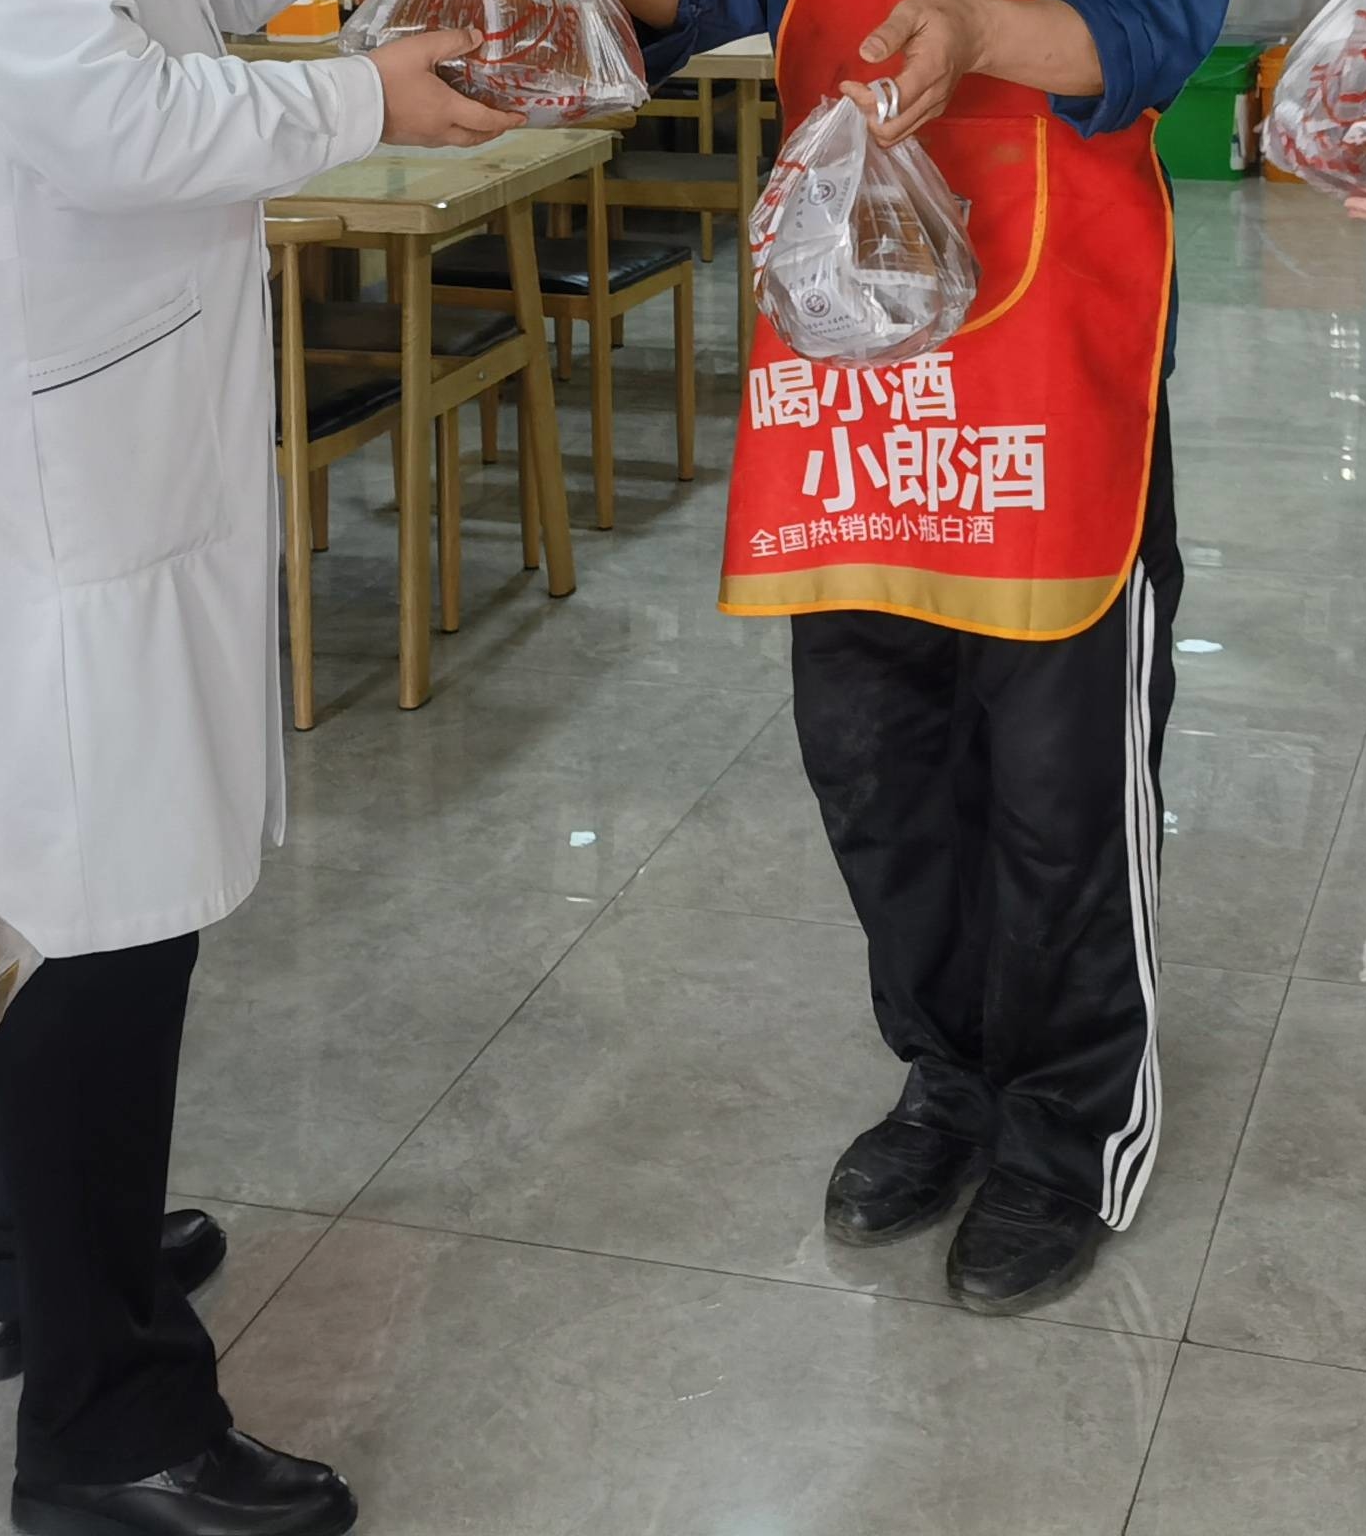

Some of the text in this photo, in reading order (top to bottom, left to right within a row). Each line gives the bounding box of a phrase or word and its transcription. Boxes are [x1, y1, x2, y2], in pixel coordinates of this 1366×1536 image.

[748, 351, 956, 431] 喝小酒
[801, 423, 1047, 514] 小郎酒
[748, 512, 995, 558] 全国热销的小瓶白酒
